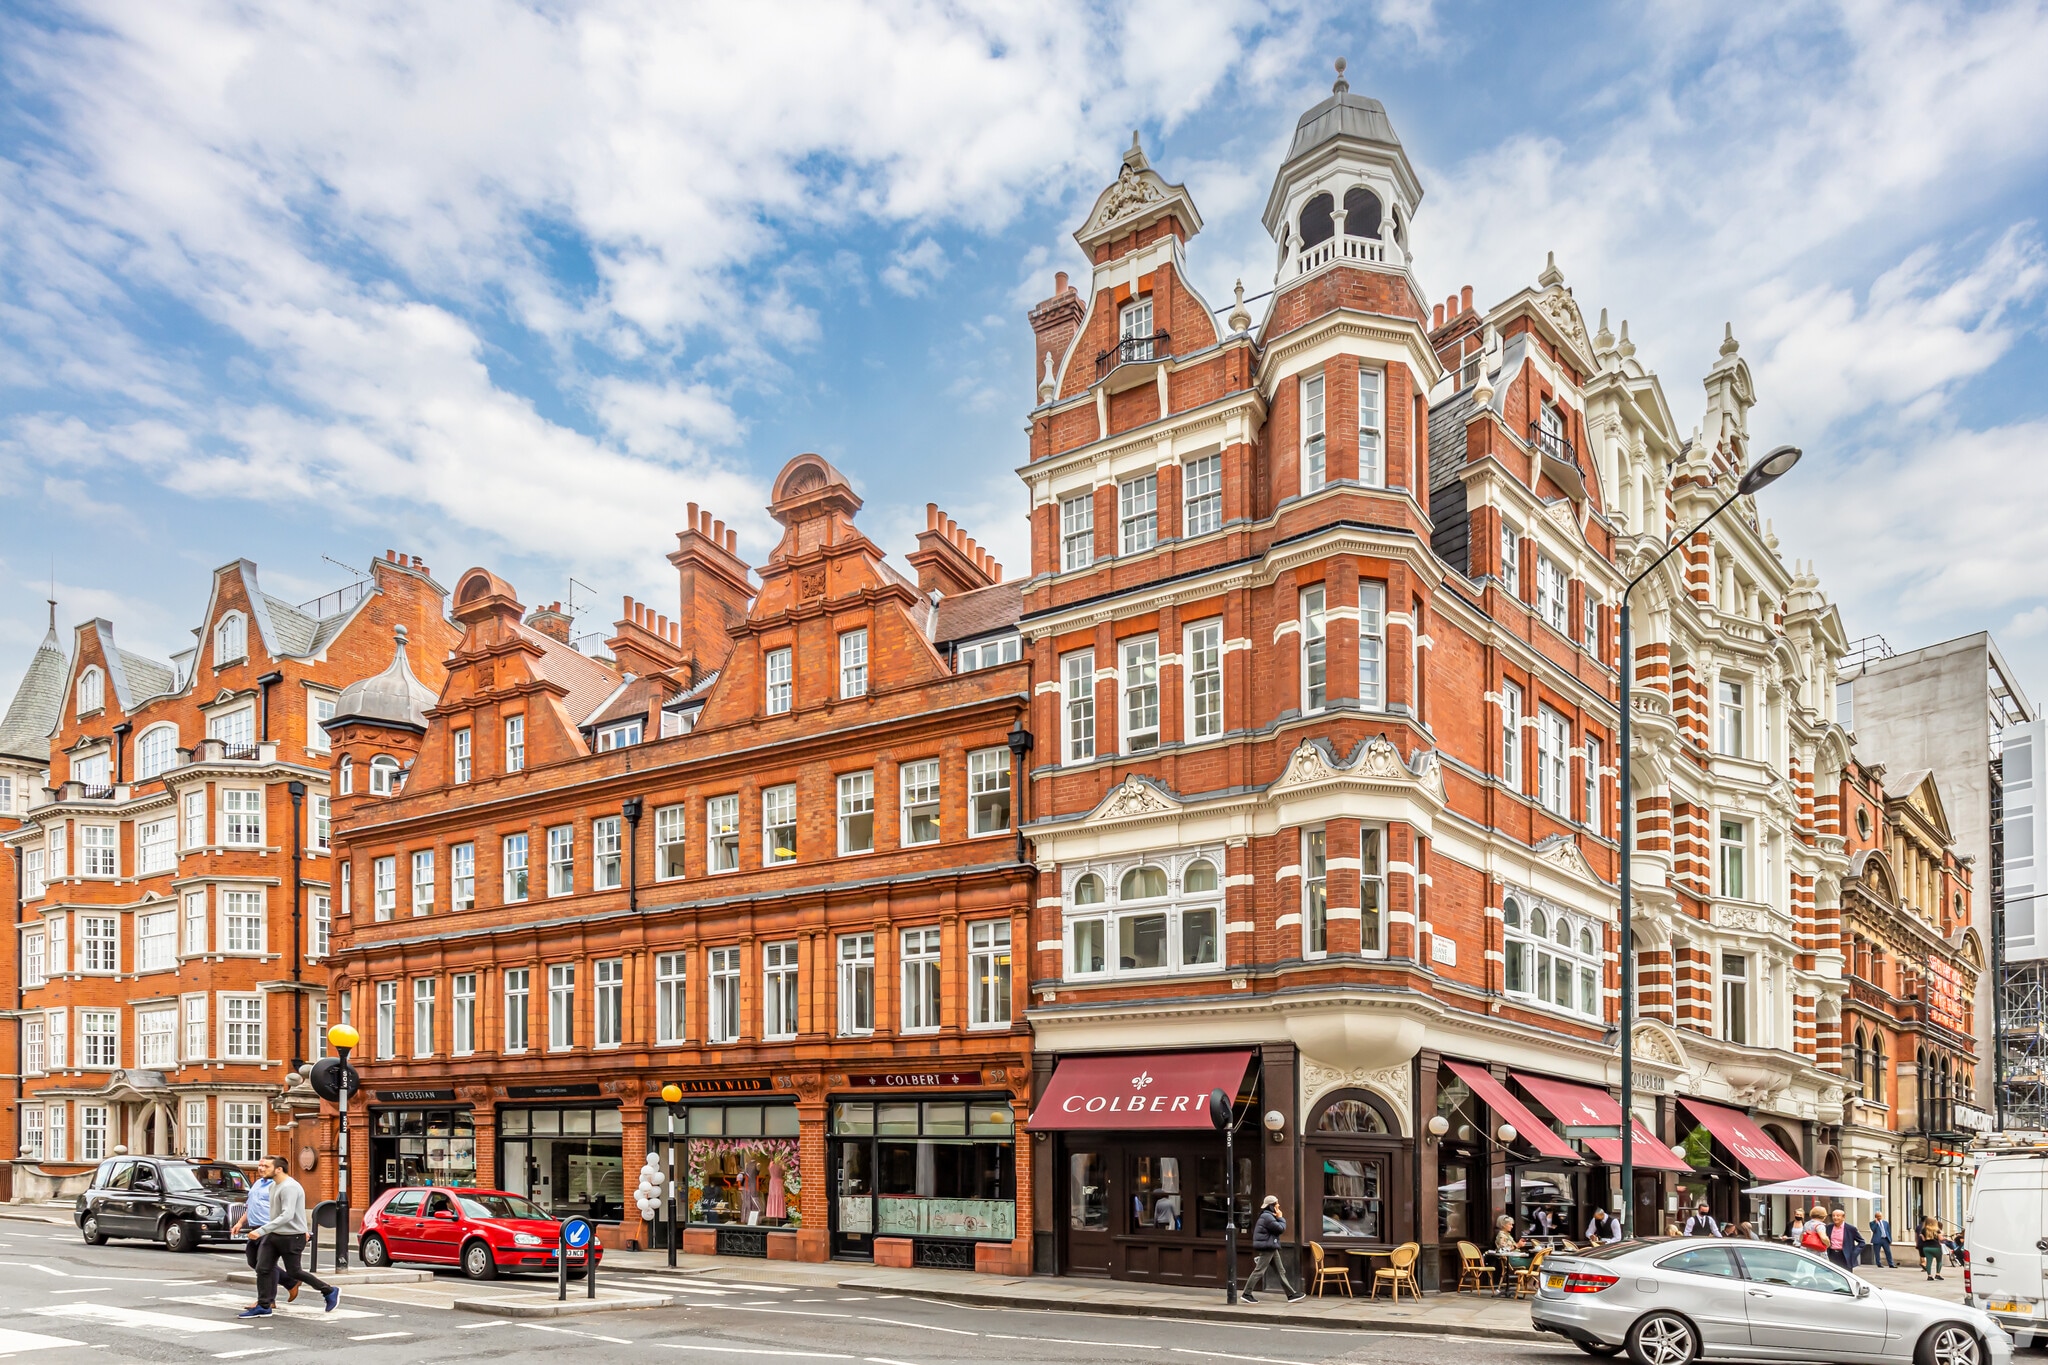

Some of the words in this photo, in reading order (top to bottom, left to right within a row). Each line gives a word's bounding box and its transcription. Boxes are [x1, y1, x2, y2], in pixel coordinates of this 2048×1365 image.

[778, 1076, 792, 1089] 53
[828, 1074, 842, 1086] 52
[885, 1074, 940, 1086] COLBERT
[990, 1069, 1006, 1083] 52
[1630, 1071, 1665, 1091] OLBERT
[727, 1080, 761, 1090] WILD
[392, 1091, 436, 1100] TATEOSSIAN
[1062, 1094, 1209, 1113] COLBERT
[1733, 1143, 1785, 1162] COLBERT
